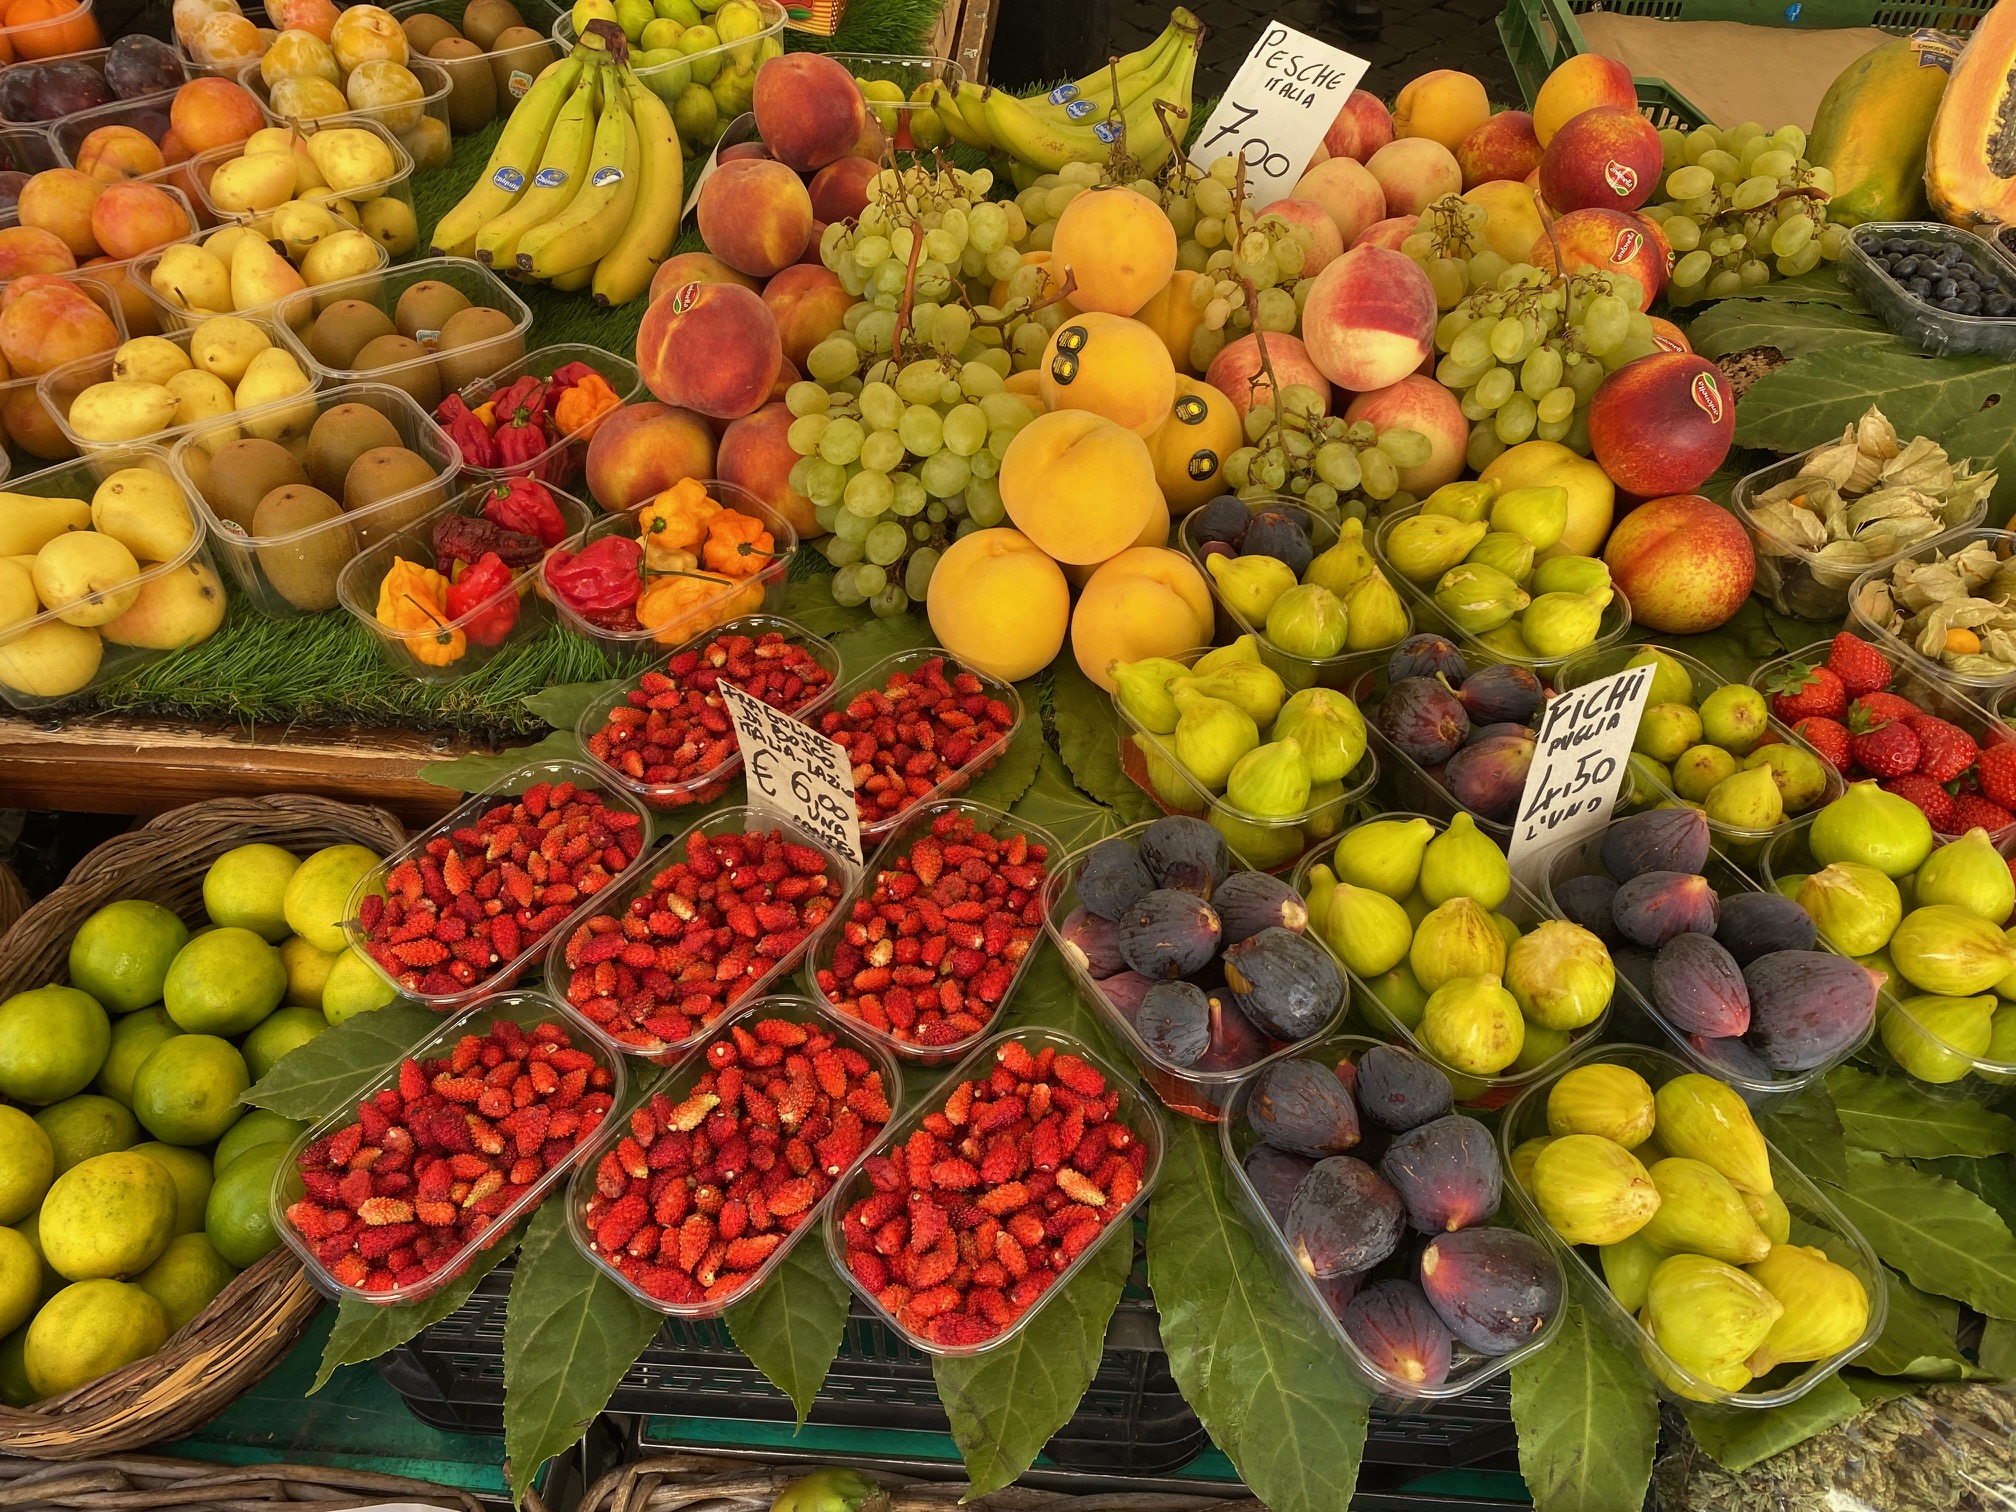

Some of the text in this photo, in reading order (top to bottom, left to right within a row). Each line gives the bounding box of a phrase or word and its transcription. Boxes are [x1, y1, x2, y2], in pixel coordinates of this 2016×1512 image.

[1254, 29, 1346, 90] PESCHE
[1264, 77, 1316, 109] ITALIA
[1617, 231, 1635, 261] antonella
[1653, 335, 1683, 353] antonell
[1698, 381, 1719, 416] antonella
[1541, 668, 1647, 744] FICHI
[1547, 712, 1620, 757] PUGLIA
[751, 748, 778, 797] €
[807, 804, 847, 841] UNA
[1524, 796, 1602, 841] L'UNO
